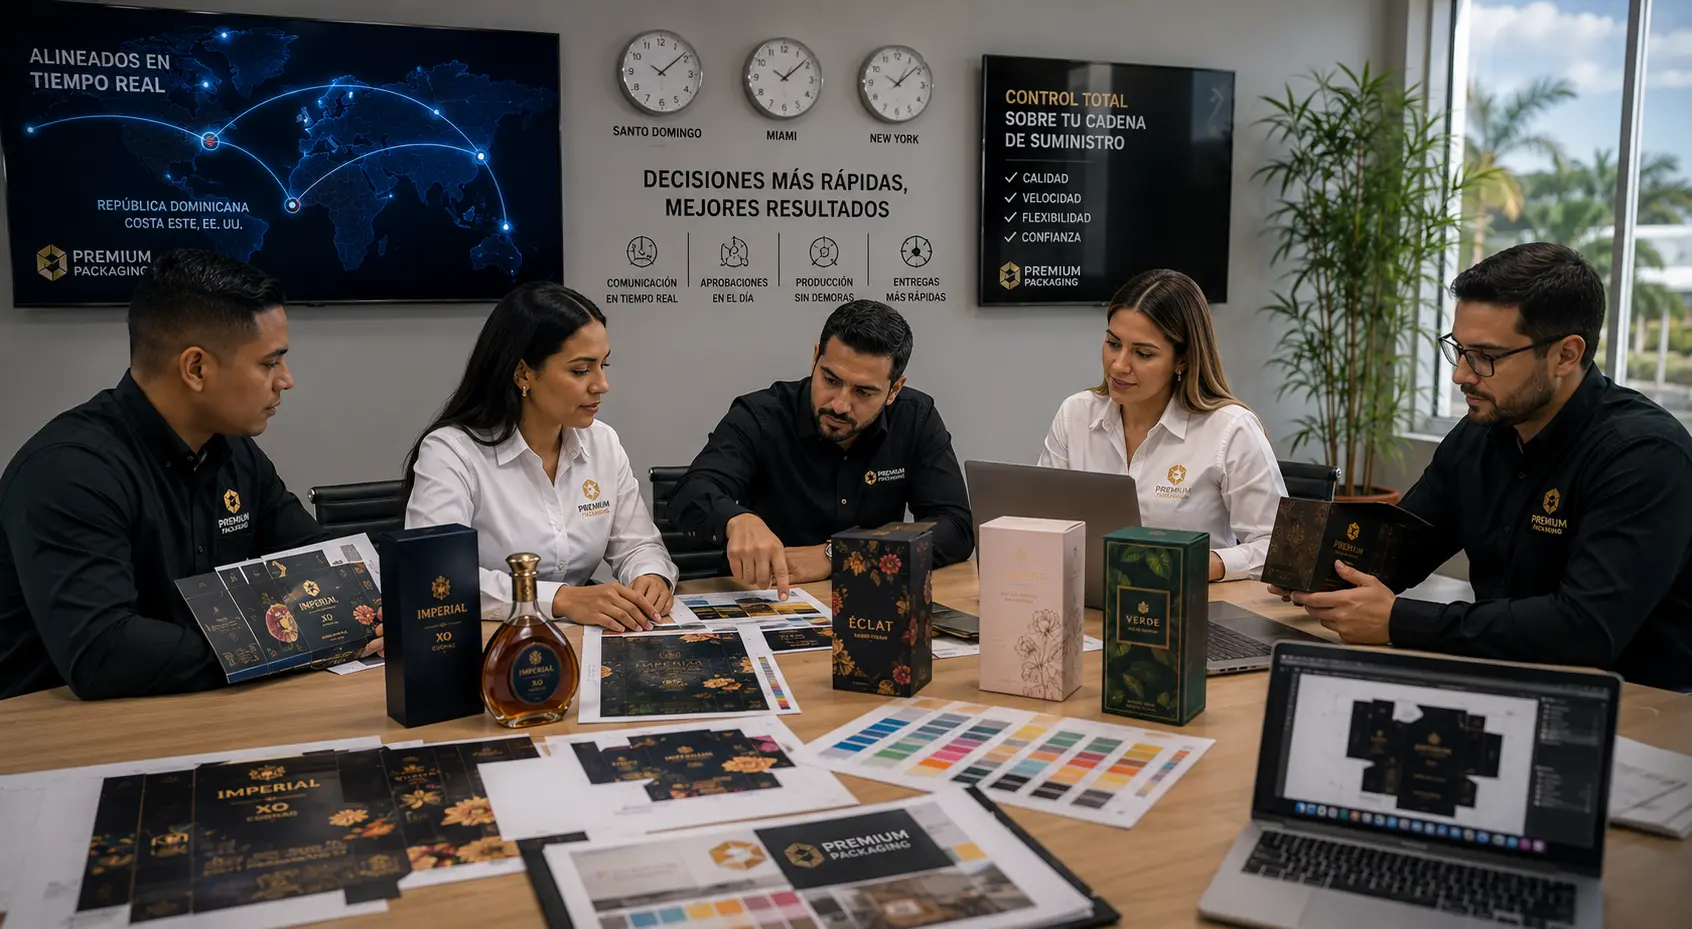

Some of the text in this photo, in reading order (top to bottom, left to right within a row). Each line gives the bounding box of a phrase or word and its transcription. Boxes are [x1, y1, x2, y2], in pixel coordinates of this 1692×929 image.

[644, 41, 650, 50] 11
[657, 38, 666, 47] 12
[30, 48, 169, 69] ALINEADOS EN
[632, 52, 642, 61] 10
[683, 55, 689, 63] 2
[628, 67, 634, 75] 9
[688, 71, 694, 79] 3
[30, 72, 165, 92] TIEMPO REAL
[634, 83, 640, 91] 8
[645, 94, 650, 102] 7
[659, 99, 665, 107] 6
[674, 96, 679, 104] 5
[1006, 90, 1128, 108] CONTROL TOTAL
[1006, 111, 1146, 129] SOBRE TU CADENA
[613, 126, 701, 138] SANTO DOMINGO
[767, 131, 796, 140] MIAMI
[870, 134, 918, 143] NEW YORK
[1006, 133, 1124, 149] DE SUMINISTRO
[644, 168, 907, 194] DECISIONES MÁS RÁPIDAS,
[1023, 173, 1068, 183] CALIDAD
[1023, 193, 1081, 203] VELOCIDAD
[98, 197, 249, 212] REPÚBLICA DOMINICANA
[666, 199, 889, 217] MEJORES RESULTADOS
[1023, 213, 1091, 222] FLEXIBILIDAD
[125, 218, 242, 230] COSTA ESTE, EE. UU.
[1022, 232, 1081, 242] CONFIANZA
[74, 250, 150, 262] PREMIUM
[1025, 266, 1080, 276] PREMIUM
[607, 276, 677, 287] COMUNICACIÓN
[701, 278, 768, 287] APROBACIONES
[796, 276, 852, 286] PRODUCCIÓN
[894, 278, 939, 286] ENTREGAS
[1025, 278, 1078, 286] PACKAGING
[606, 294, 678, 303] EN TIEMPO REAL
[713, 292, 753, 302] EN EL DÍA
[795, 293, 854, 302] SIN DEMORAS
[886, 291, 946, 302] MÁS RÁPIDAS
[417, 603, 468, 620] IMPERIAL
[849, 615, 893, 632] ÉCLAT
[1126, 615, 1160, 627] VERDE
[436, 631, 452, 643] XO
[217, 779, 320, 800] IMPERIAL
[255, 802, 289, 814] XO
[821, 829, 910, 853] PREMIUM
[829, 839, 911, 861] PACKAGING
